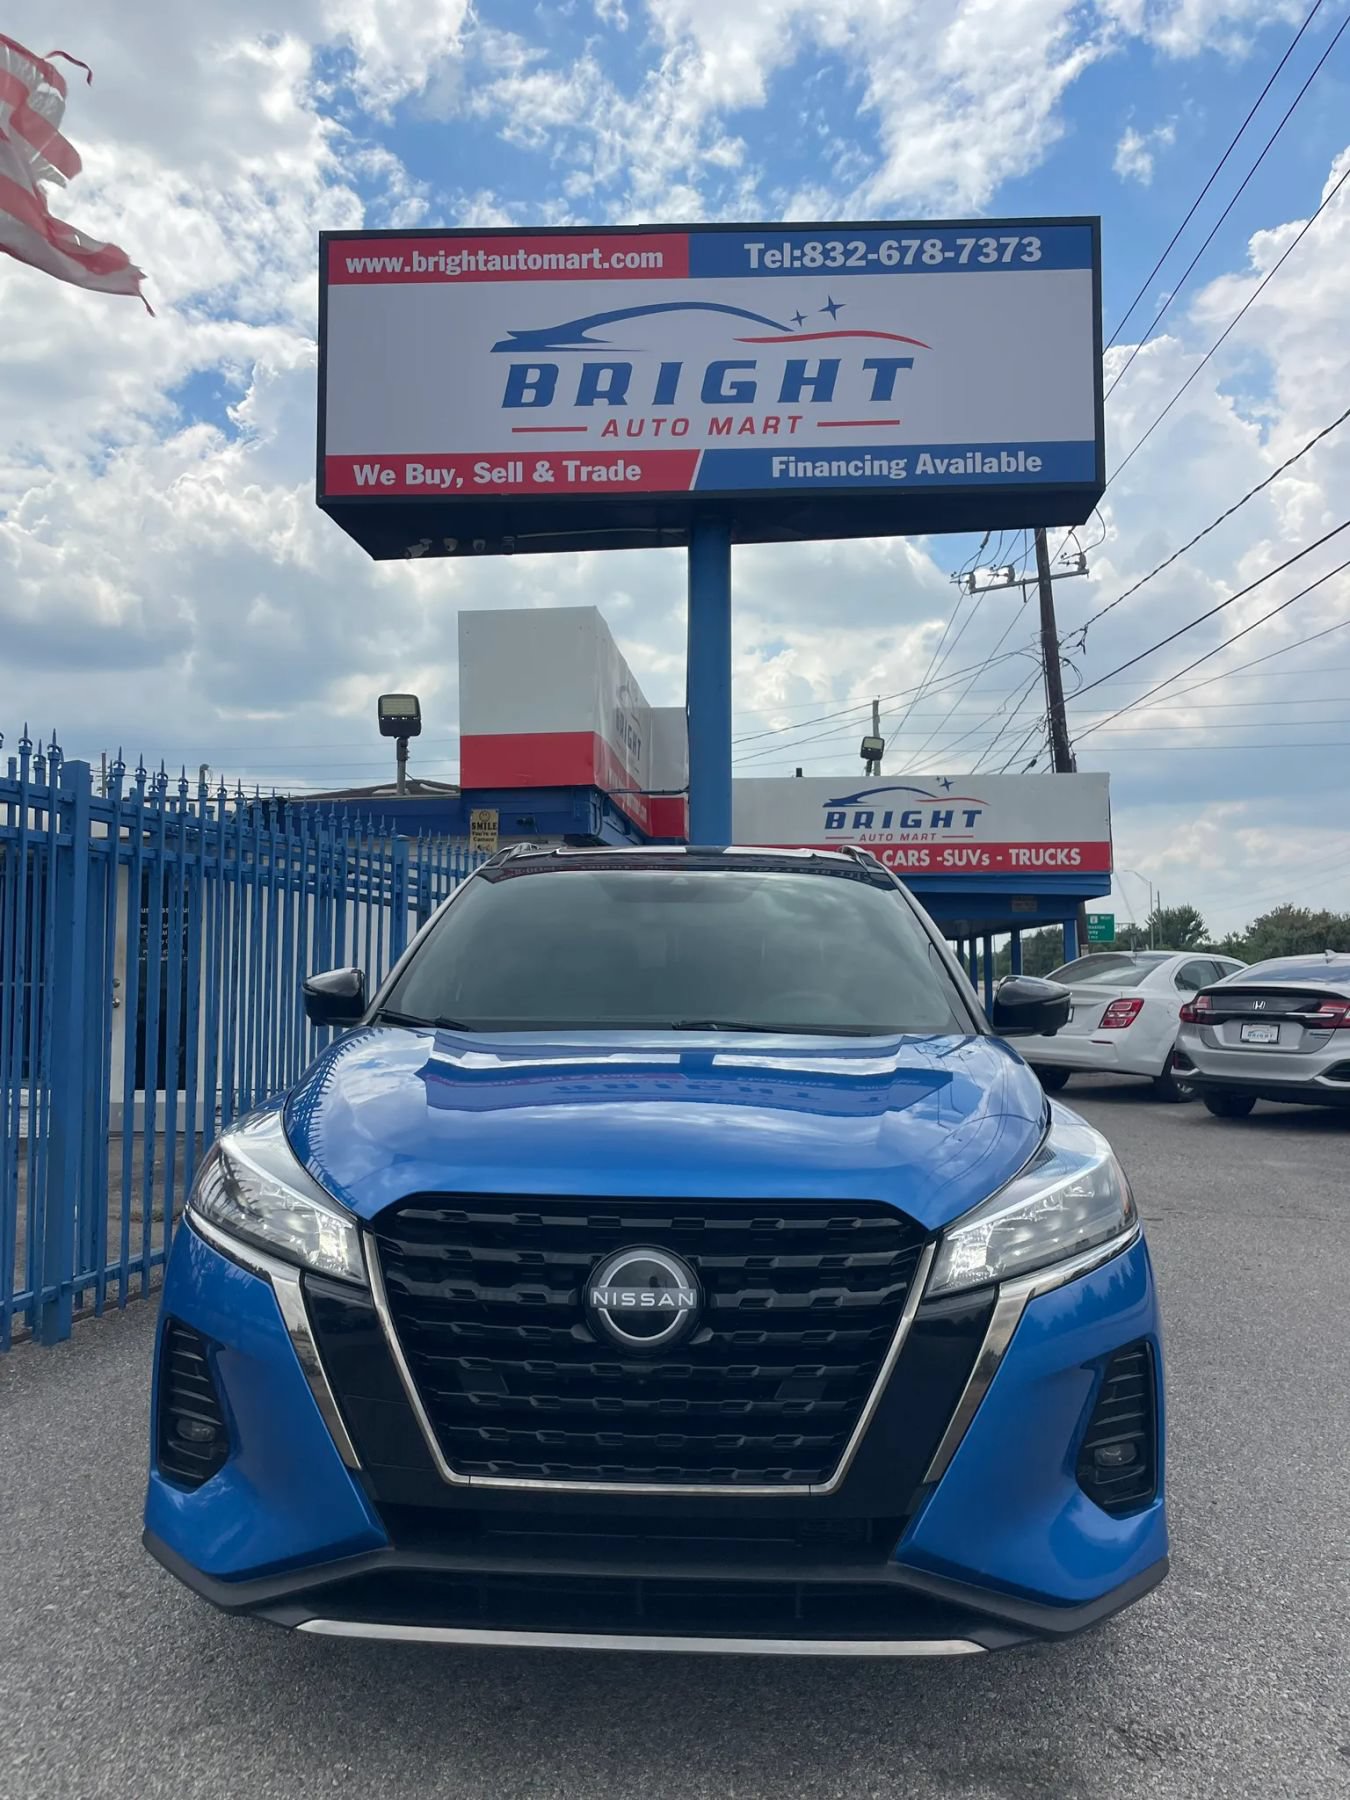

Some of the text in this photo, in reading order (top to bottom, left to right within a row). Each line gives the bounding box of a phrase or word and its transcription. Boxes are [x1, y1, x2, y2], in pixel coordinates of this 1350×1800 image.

[345, 248, 664, 276] www.brightautomart.com
[743, 236, 1042, 269] Tel:832-678-7373
[501, 357, 915, 409] BRIGHT
[601, 415, 804, 438] AUTO MART
[352, 459, 642, 489] We Buy, Sell & Trade
[771, 450, 1043, 480] Financing Available
[471, 822, 497, 830] SMILE
[824, 809, 983, 830] BRIGHT
[858, 832, 937, 842] AUTO MART
[882, 849, 930, 867] CARS
[1008, 848, 1081, 866] TRUCKS
[593, 1291, 694, 1307] NISSAN
